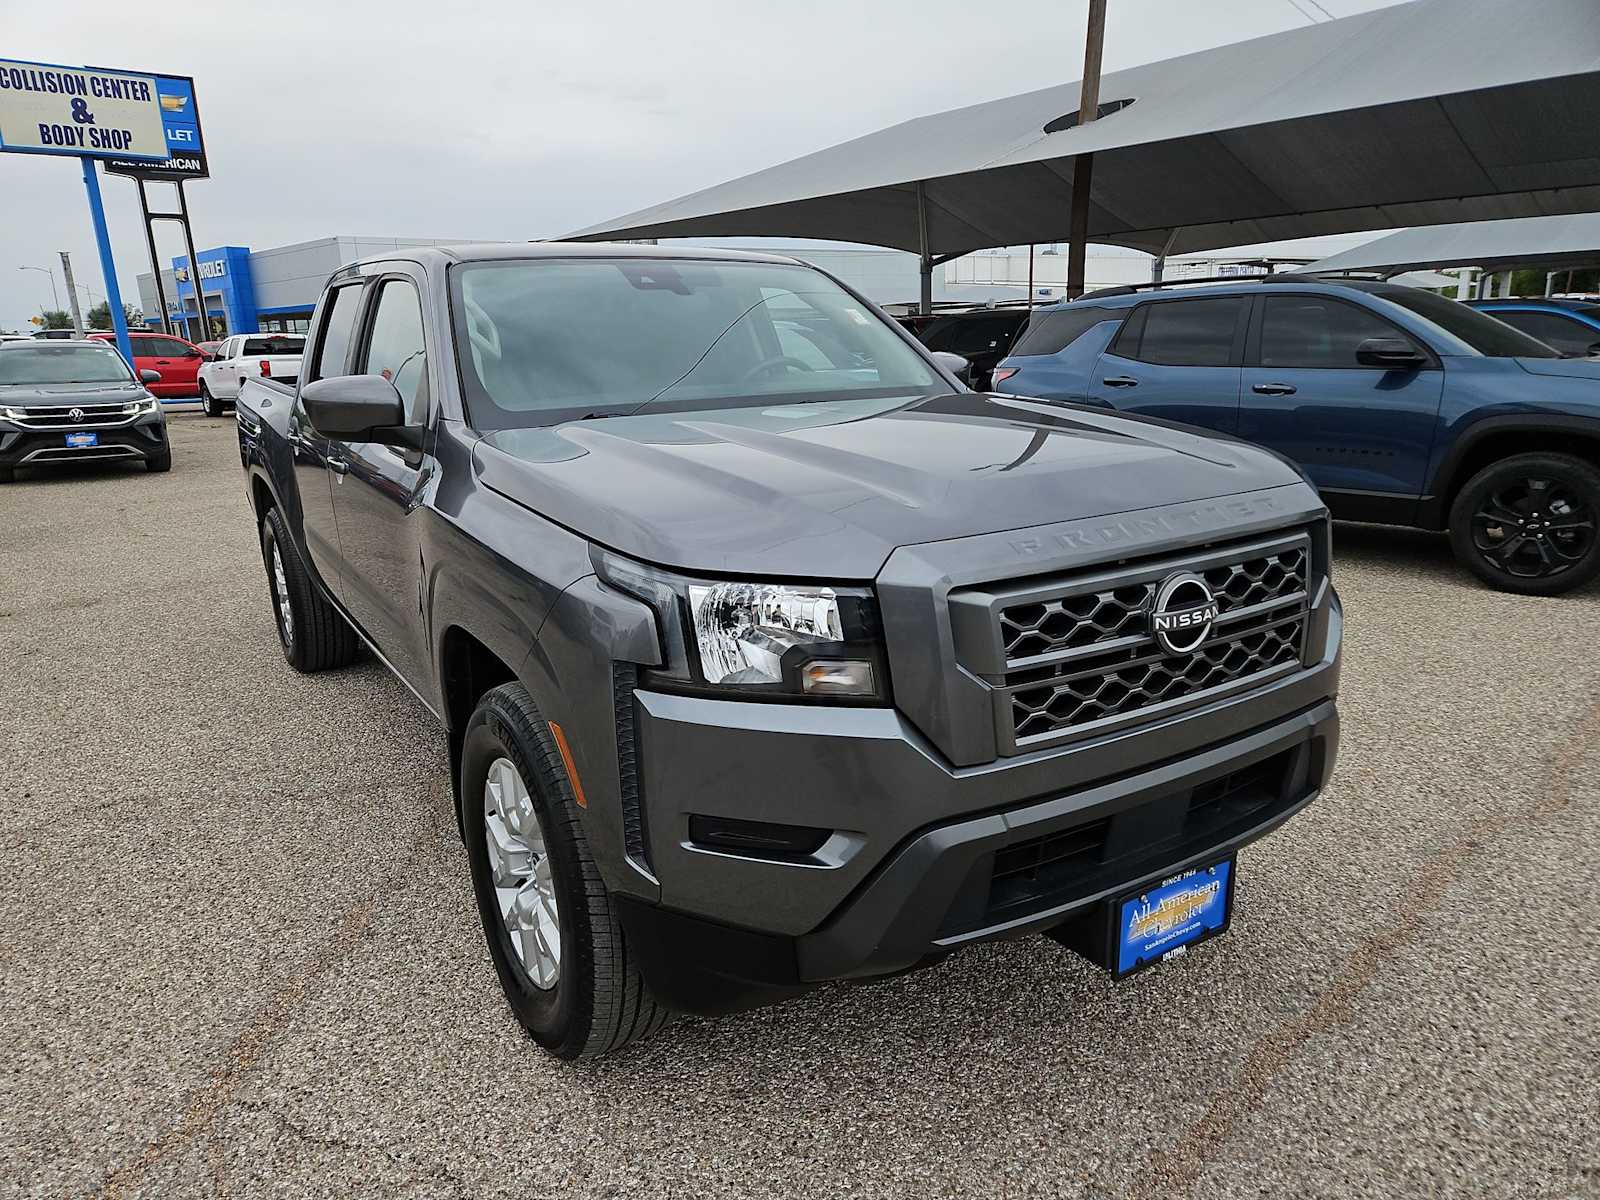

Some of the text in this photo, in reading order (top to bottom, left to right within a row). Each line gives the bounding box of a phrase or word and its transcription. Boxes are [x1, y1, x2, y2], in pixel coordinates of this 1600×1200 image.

[0, 66, 151, 102] COLLISION CENTER
[70, 97, 95, 125] &
[39, 123, 133, 150] BODY SHOP
[1155, 605, 1219, 630] NISSAN
[1161, 874, 1183, 888] SINCE
[1129, 880, 1220, 928] All American
[1142, 902, 1203, 938] Chevrolet
